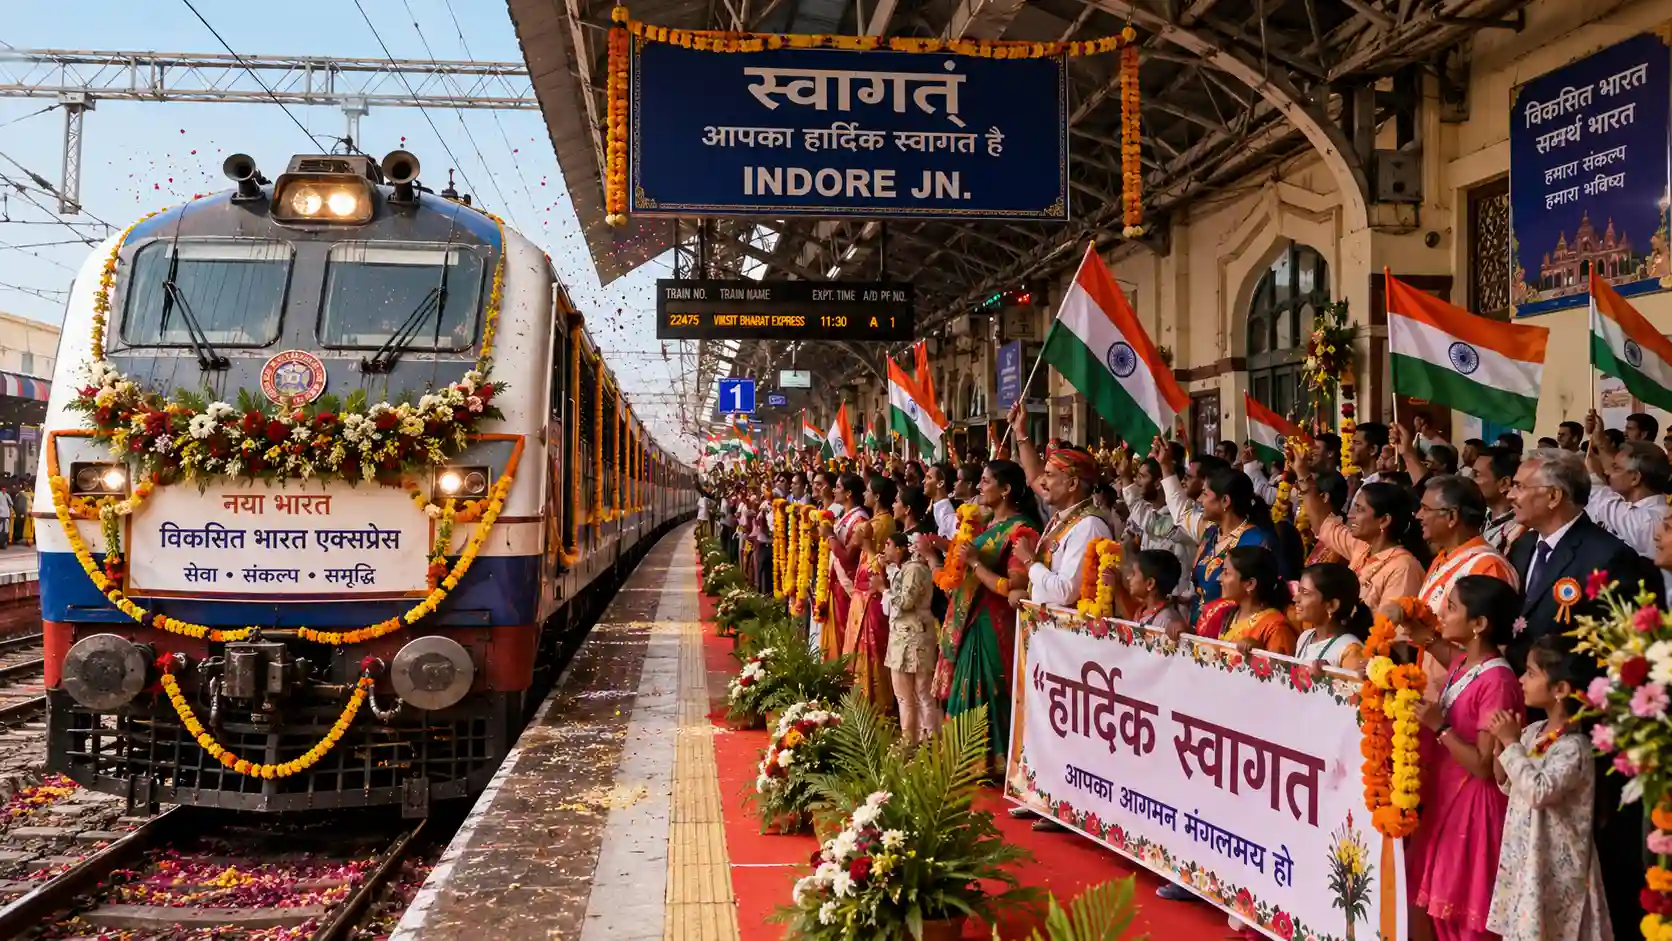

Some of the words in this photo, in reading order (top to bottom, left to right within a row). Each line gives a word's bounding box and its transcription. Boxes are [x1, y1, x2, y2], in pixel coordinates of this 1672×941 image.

[1524, 86, 1595, 129] विकसित
[1599, 62, 1649, 97] भारत
[702, 126, 795, 149] आपका
[802, 121, 886, 153] हार्दिक
[893, 131, 978, 153] स्वागत
[985, 126, 1005, 157] है
[1535, 114, 1583, 155] समर्थ
[1588, 102, 1636, 134] भारत
[1544, 160, 1580, 185] हमारा
[1582, 144, 1627, 172] संकल्प
[743, 166, 897, 199] INDORE
[911, 170, 972, 200] JN.
[1544, 186, 1580, 210] हमारा
[1583, 172, 1626, 196] भविष्य
[665, 288, 692, 300] TRAIN
[693, 289, 708, 300] NO.
[720, 288, 745, 300] TRAIN
[746, 289, 771, 301] NAME
[812, 289, 836, 301] EXPT.
[837, 290, 856, 301] TIME
[863, 290, 878, 301] A/D
[892, 291, 907, 302] NO.
[670, 314, 699, 326] 22475
[713, 314, 739, 326] VIKSIT
[740, 315, 770, 327] BHARAT
[771, 316, 806, 327] EXPRESS
[820, 316, 848, 327] 11:30
[869, 316, 879, 328] A
[889, 316, 896, 328] 1
[729, 383, 742, 410] 1
[222, 494, 266, 515] नया
[274, 494, 333, 516] भारत
[158, 521, 247, 549] विकसित
[254, 528, 308, 550] भारत
[314, 522, 402, 553] एक्सप्रेस
[183, 562, 218, 583] सेवा
[241, 564, 300, 583] संकल्प
[1171, 711, 1325, 828] स्वागत
[1065, 764, 1114, 803] आपका
[1119, 786, 1178, 832] आगमन
[1183, 809, 1267, 874] मंगलमय
[1272, 844, 1295, 888] हो
